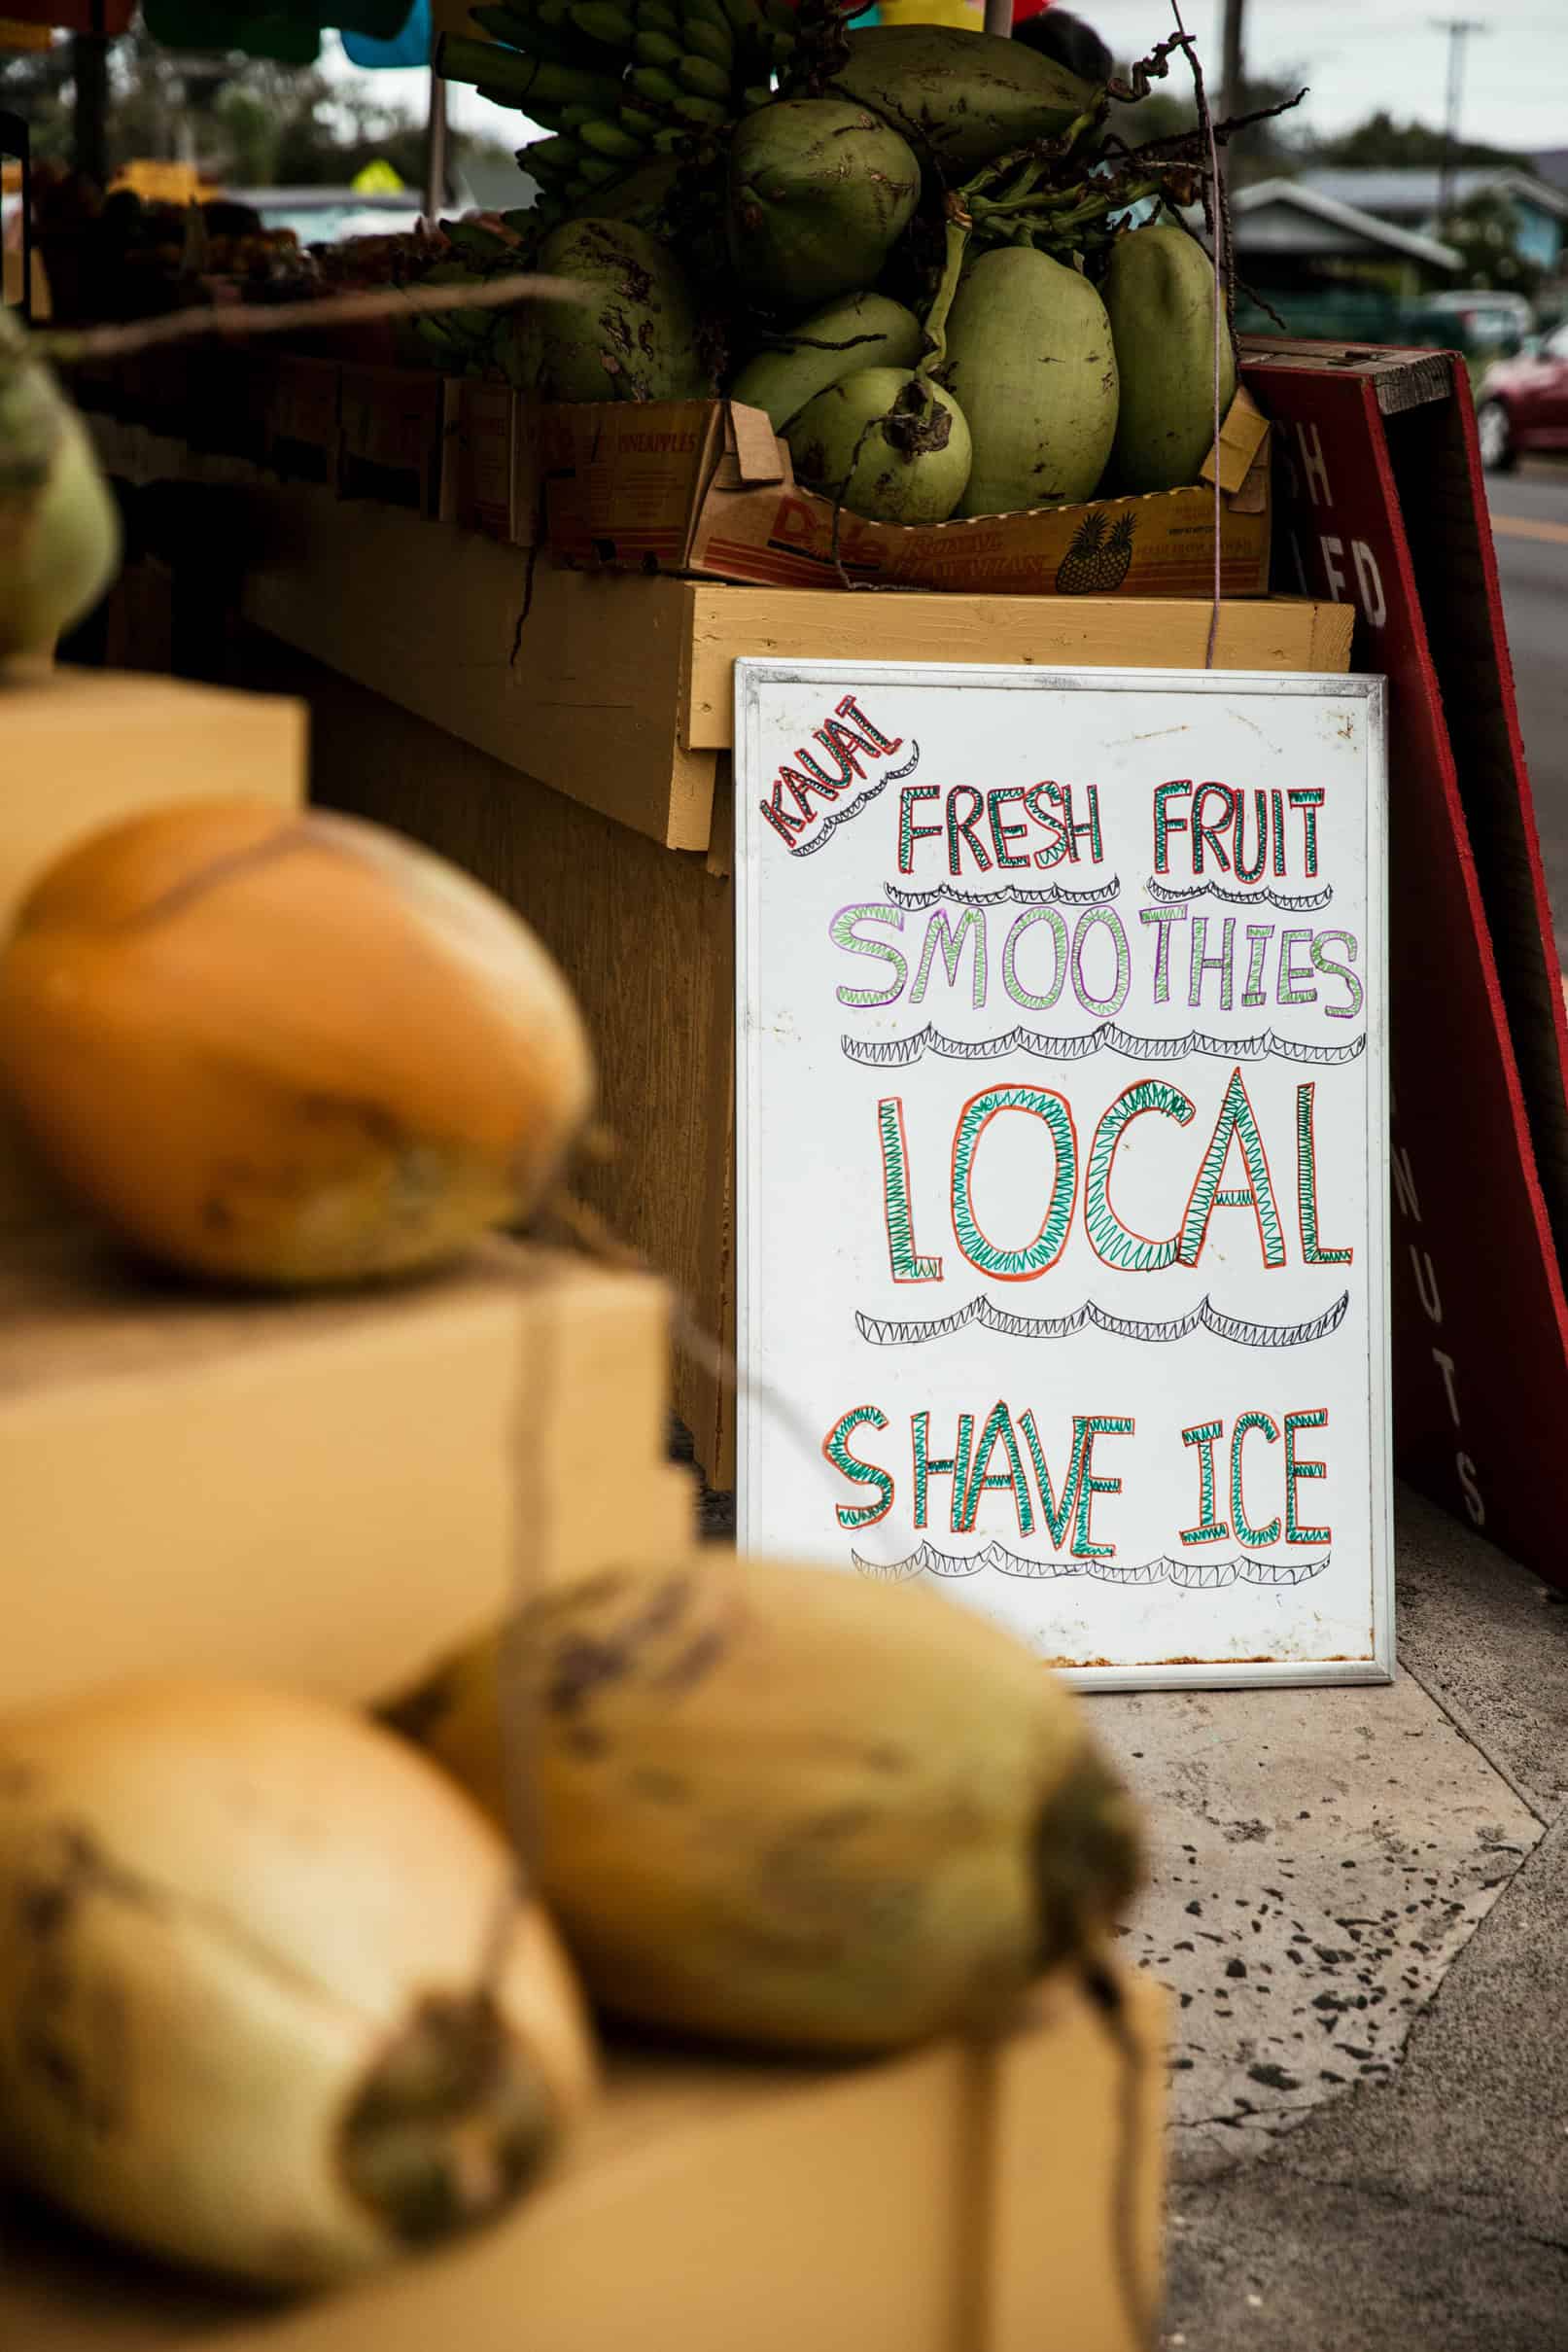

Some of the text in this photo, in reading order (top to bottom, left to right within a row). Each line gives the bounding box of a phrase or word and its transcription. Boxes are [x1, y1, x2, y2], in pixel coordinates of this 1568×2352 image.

[760, 695, 903, 848] KAUAI
[898, 780, 1326, 883] FRESH FRUIT
[829, 903, 1364, 1019] SMOOTHIES
[878, 1066, 1354, 1283] LOCAL
[1390, 1079, 1485, 1527] NUTS
[822, 1399, 1332, 1558] SHAVE ICE
